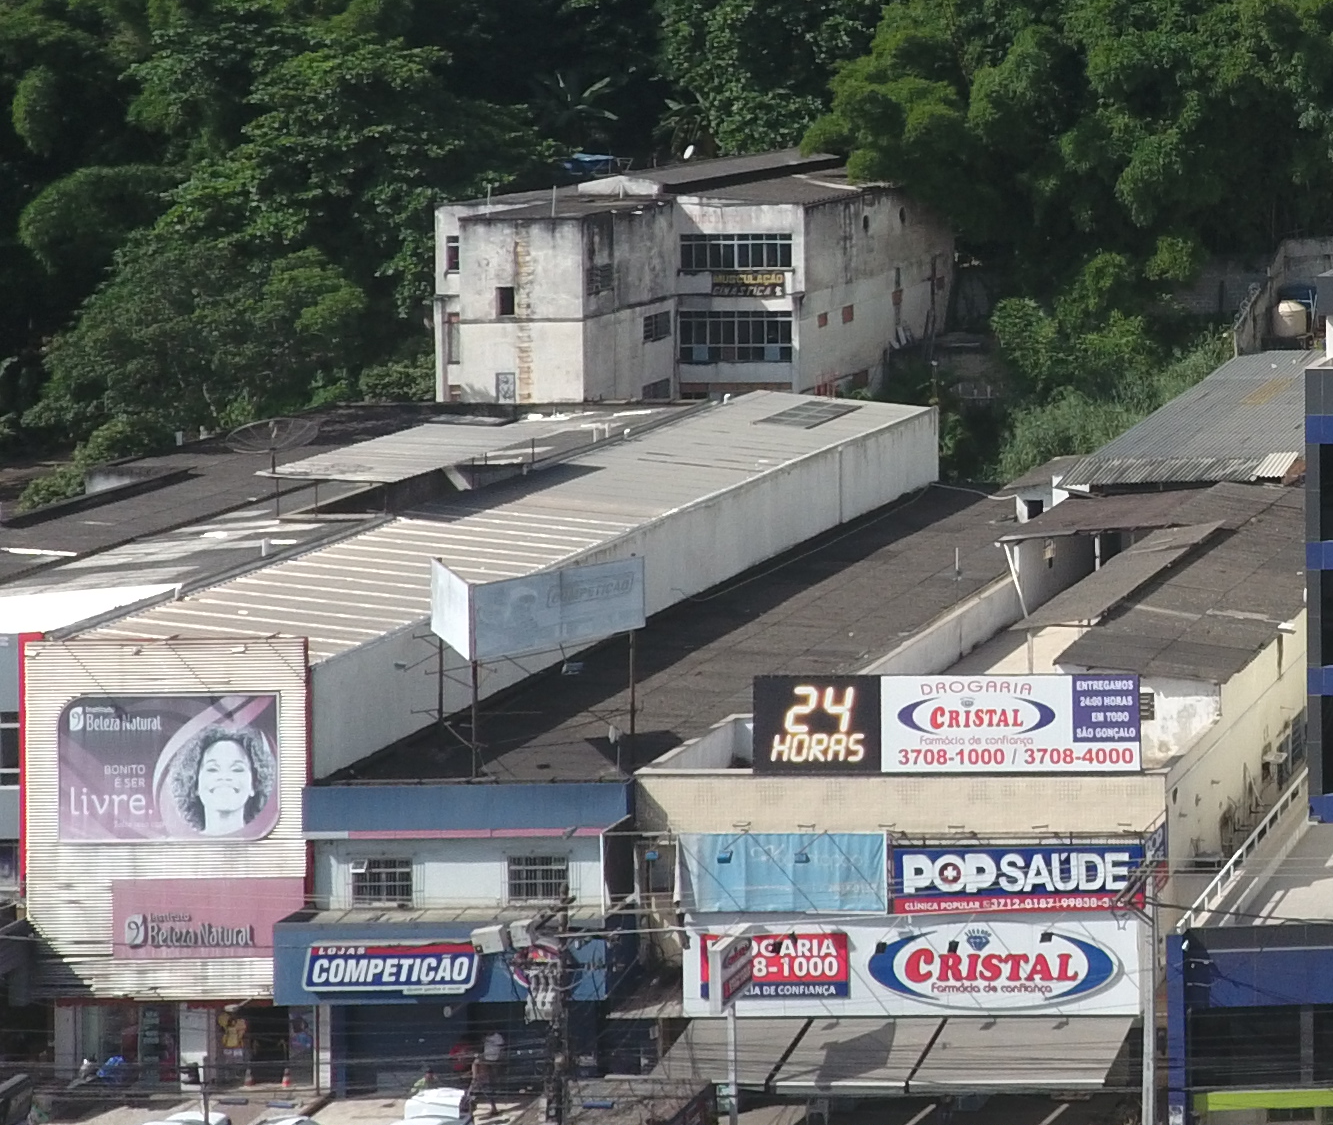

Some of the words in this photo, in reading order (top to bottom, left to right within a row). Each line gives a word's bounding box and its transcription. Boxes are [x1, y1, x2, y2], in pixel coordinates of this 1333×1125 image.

[919, 680, 1033, 697] DROGARIA
[1076, 679, 1134, 691] ENTREGAMOS
[785, 685, 856, 733] 24
[1103, 695, 1133, 707] HORAS
[86, 713, 120, 732] Beleza
[122, 713, 162, 732] Natural
[929, 704, 1025, 730] CRISTAL
[1091, 711, 1104, 722] EM
[1105, 711, 1130, 722] TODO
[769, 732, 866, 763] HORAS
[967, 734, 982, 746] de
[983, 734, 1034, 747] confiança
[898, 749, 1006, 766] 3708-1000
[1023, 747, 1135, 765] 3708-4000
[103, 764, 146, 776] BONITO
[124, 777, 146, 789] SER
[70, 786, 154, 816] livre.
[904, 900, 939, 912] CLÍNICA
[940, 899, 981, 912] POPULAR
[148, 922, 195, 946] Beleza
[198, 921, 254, 946] Natural
[318, 946, 367, 956] LOJAS
[312, 954, 470, 985] COMPETIÇÃO
[904, 947, 1079, 984] CRISTAL
[762, 985, 776, 996] DE
[777, 984, 837, 997] CONFIANÇA
[982, 982, 999, 994] de
[1000, 981, 1054, 996] confiança
